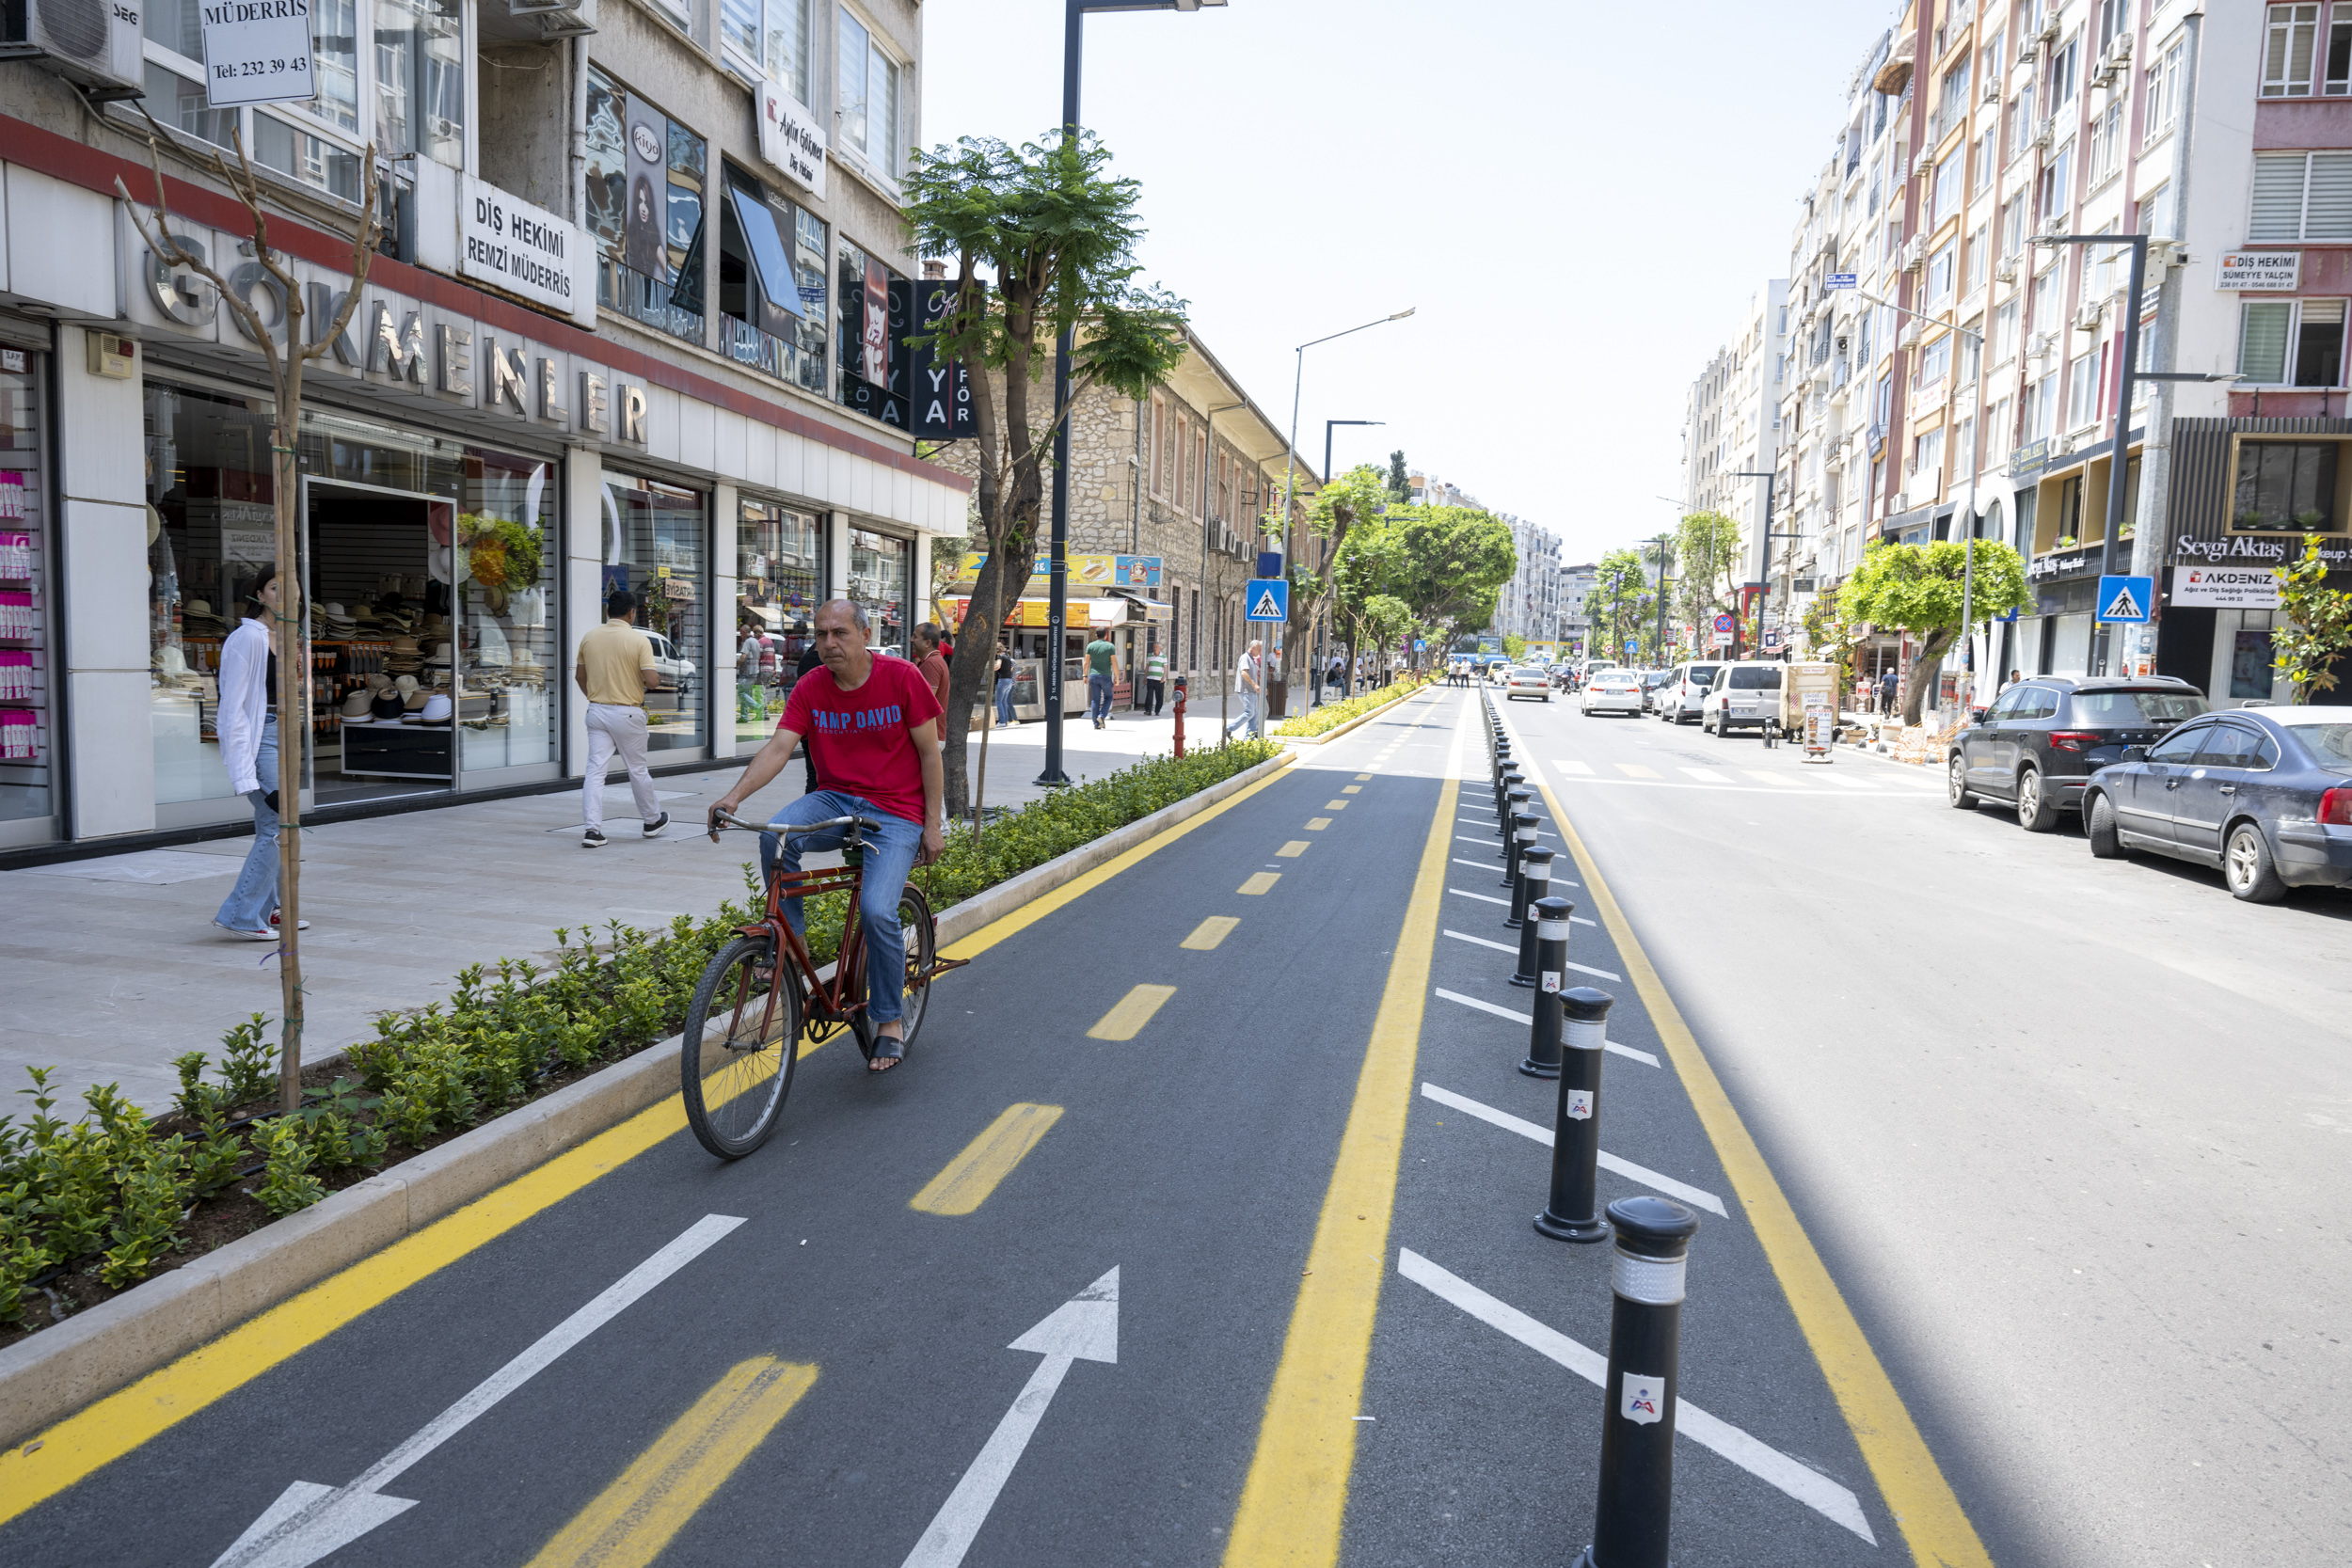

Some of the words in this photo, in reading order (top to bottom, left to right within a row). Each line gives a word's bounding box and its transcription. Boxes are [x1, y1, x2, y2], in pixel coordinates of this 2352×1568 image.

[114, 3, 137, 25] SEG
[213, 64, 237, 79] Tel:
[241, 62, 264, 77] 232
[270, 59, 285, 74] 39
[290, 57, 307, 72] 43
[780, 111, 799, 146] Aylin
[476, 197, 503, 236] DİŞ
[512, 214, 564, 259] HEKİMİ
[469, 236, 508, 273] REMZİ
[511, 253, 570, 298] MÜDERRİS
[2237, 255, 2255, 270] DİŞ
[2257, 255, 2296, 267] HEKİMİ
[2223, 270, 2262, 279] SÜMEYYE
[2265, 271, 2293, 281] YALÇIN
[146, 234, 648, 444] GÖKMENLER
[2177, 534, 2228, 562] Sevgi
[2230, 535, 2284, 562] Aktaş
[2221, 586, 2243, 594] Sağlığı
[812, 709, 850, 729] CAMP
[856, 705, 901, 729] DAVID
